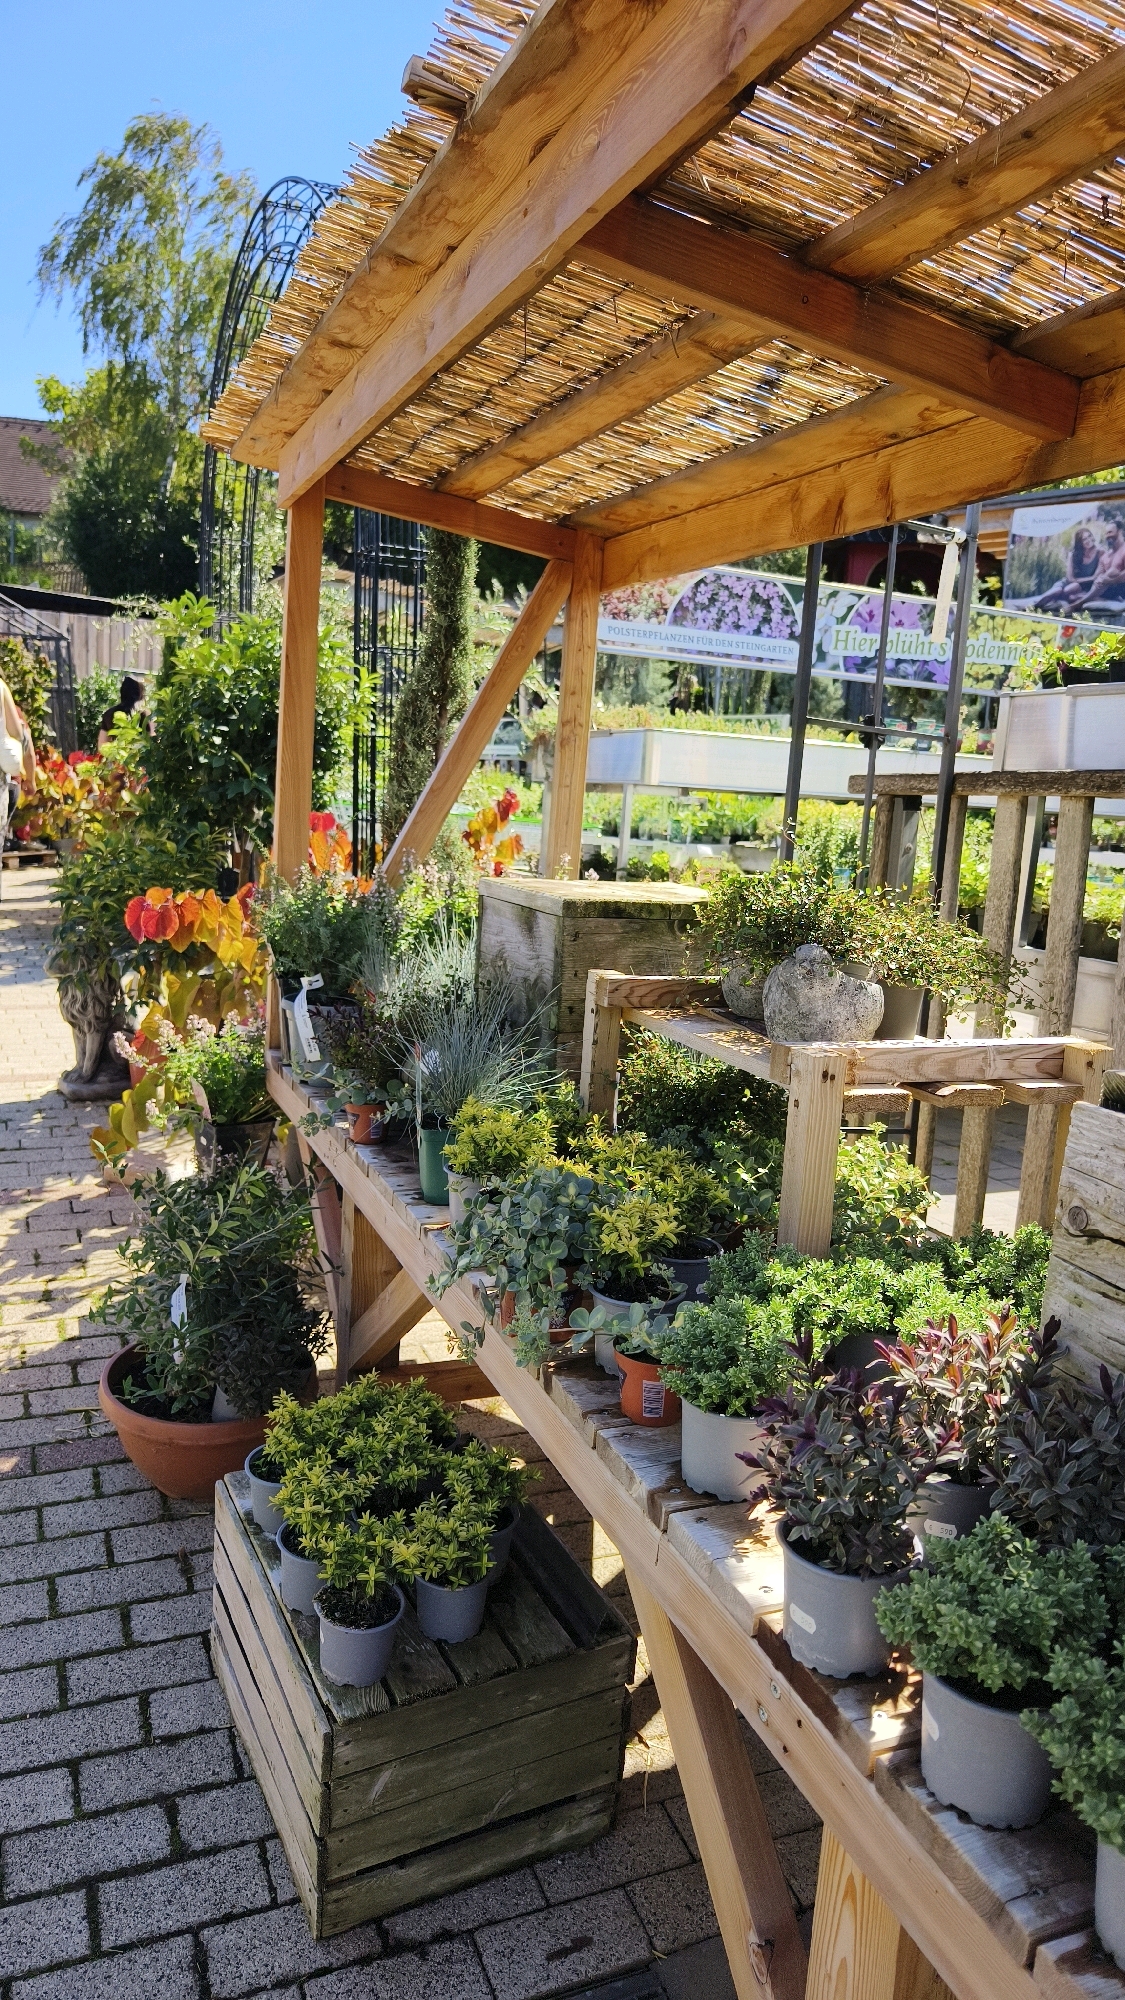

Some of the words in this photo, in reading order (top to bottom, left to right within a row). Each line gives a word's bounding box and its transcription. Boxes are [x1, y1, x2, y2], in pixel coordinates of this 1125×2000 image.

[607, 625, 694, 645] POLSTERPFLANZEN
[696, 636, 714, 647] FÜR
[715, 638, 734, 650] DEN
[735, 641, 794, 655] STEINGARTEN
[833, 629, 878, 652] Hier
[940, 1527, 953, 1536] 590
